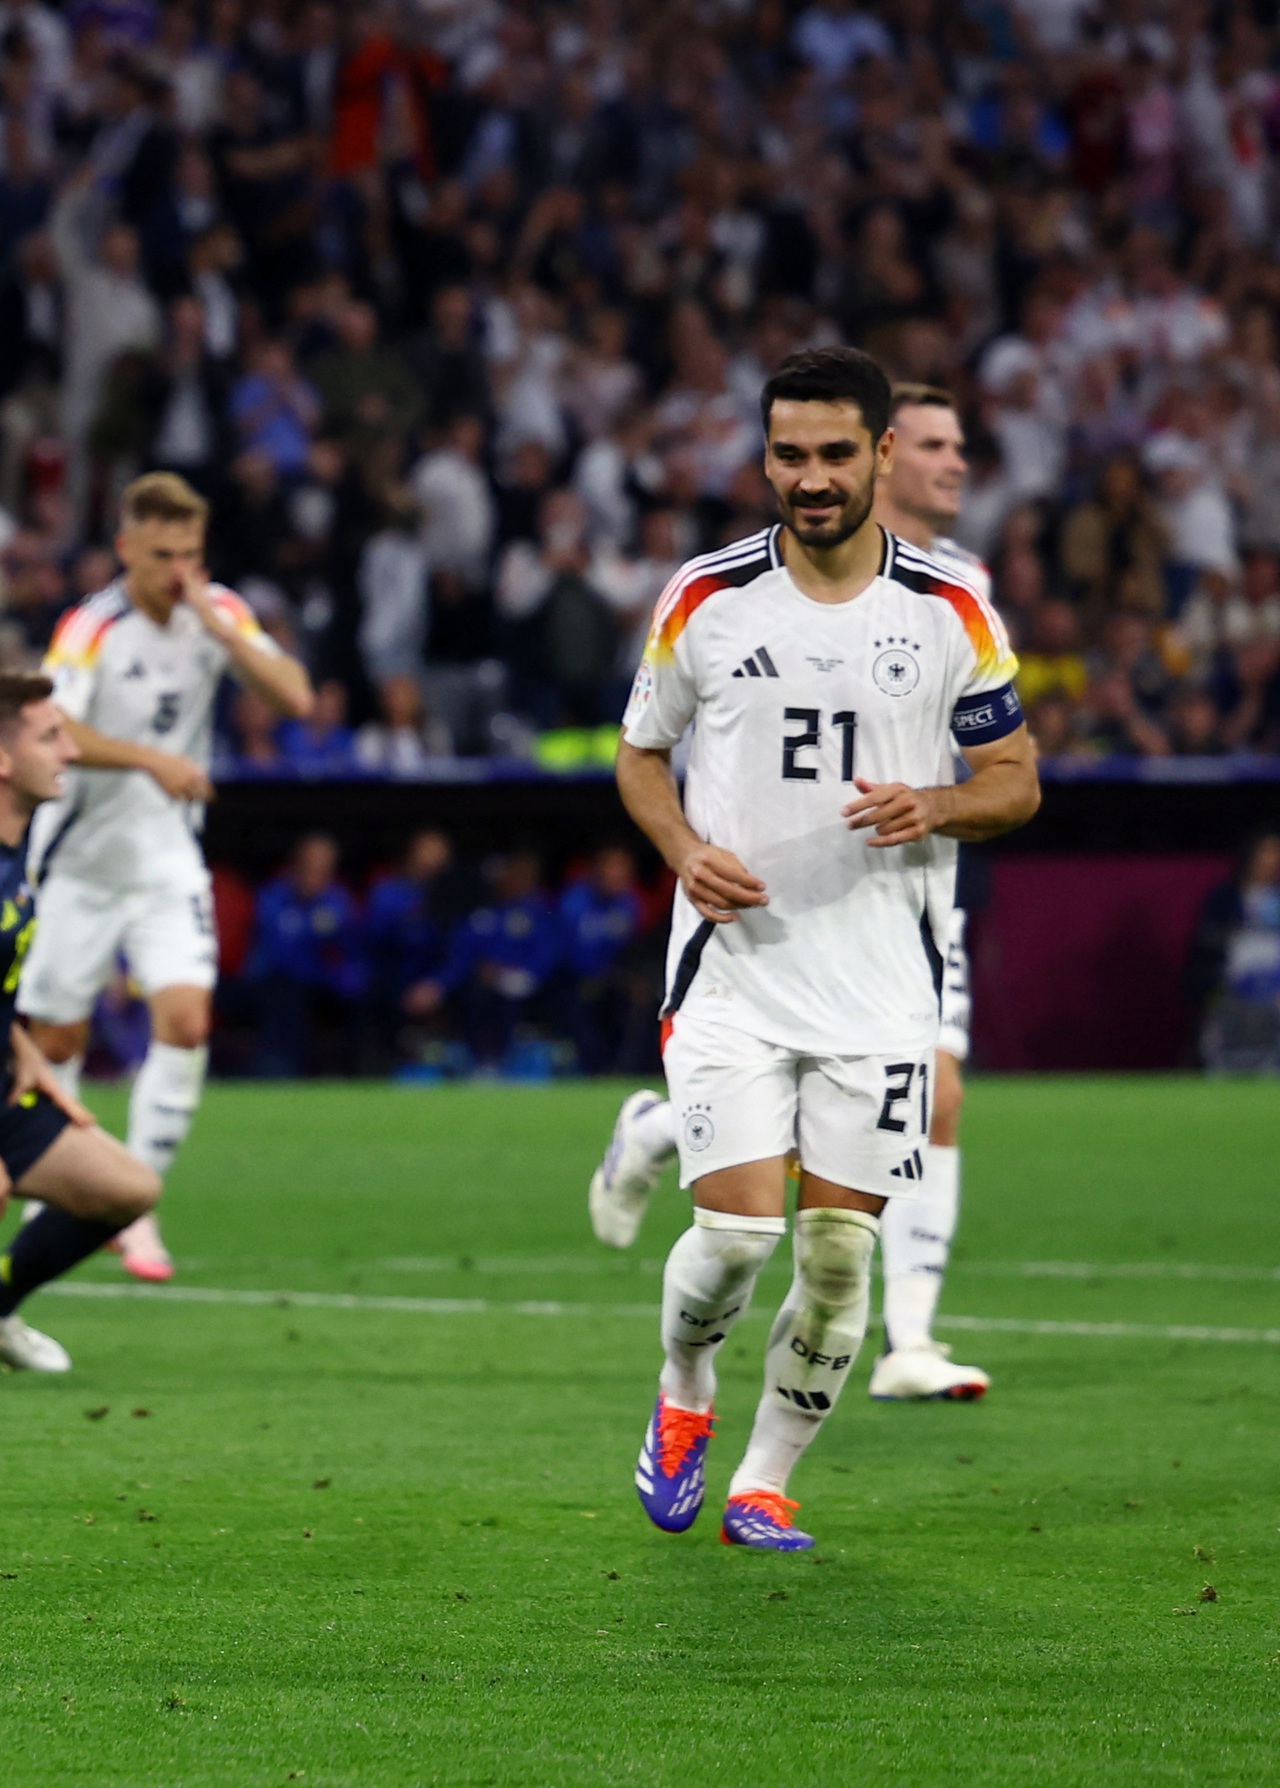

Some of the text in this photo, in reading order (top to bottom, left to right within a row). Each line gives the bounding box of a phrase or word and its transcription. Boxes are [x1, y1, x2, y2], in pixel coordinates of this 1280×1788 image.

[782, 707, 858, 784] 21
[877, 1063, 927, 1137] 21
[790, 1336, 851, 1371] DFB
